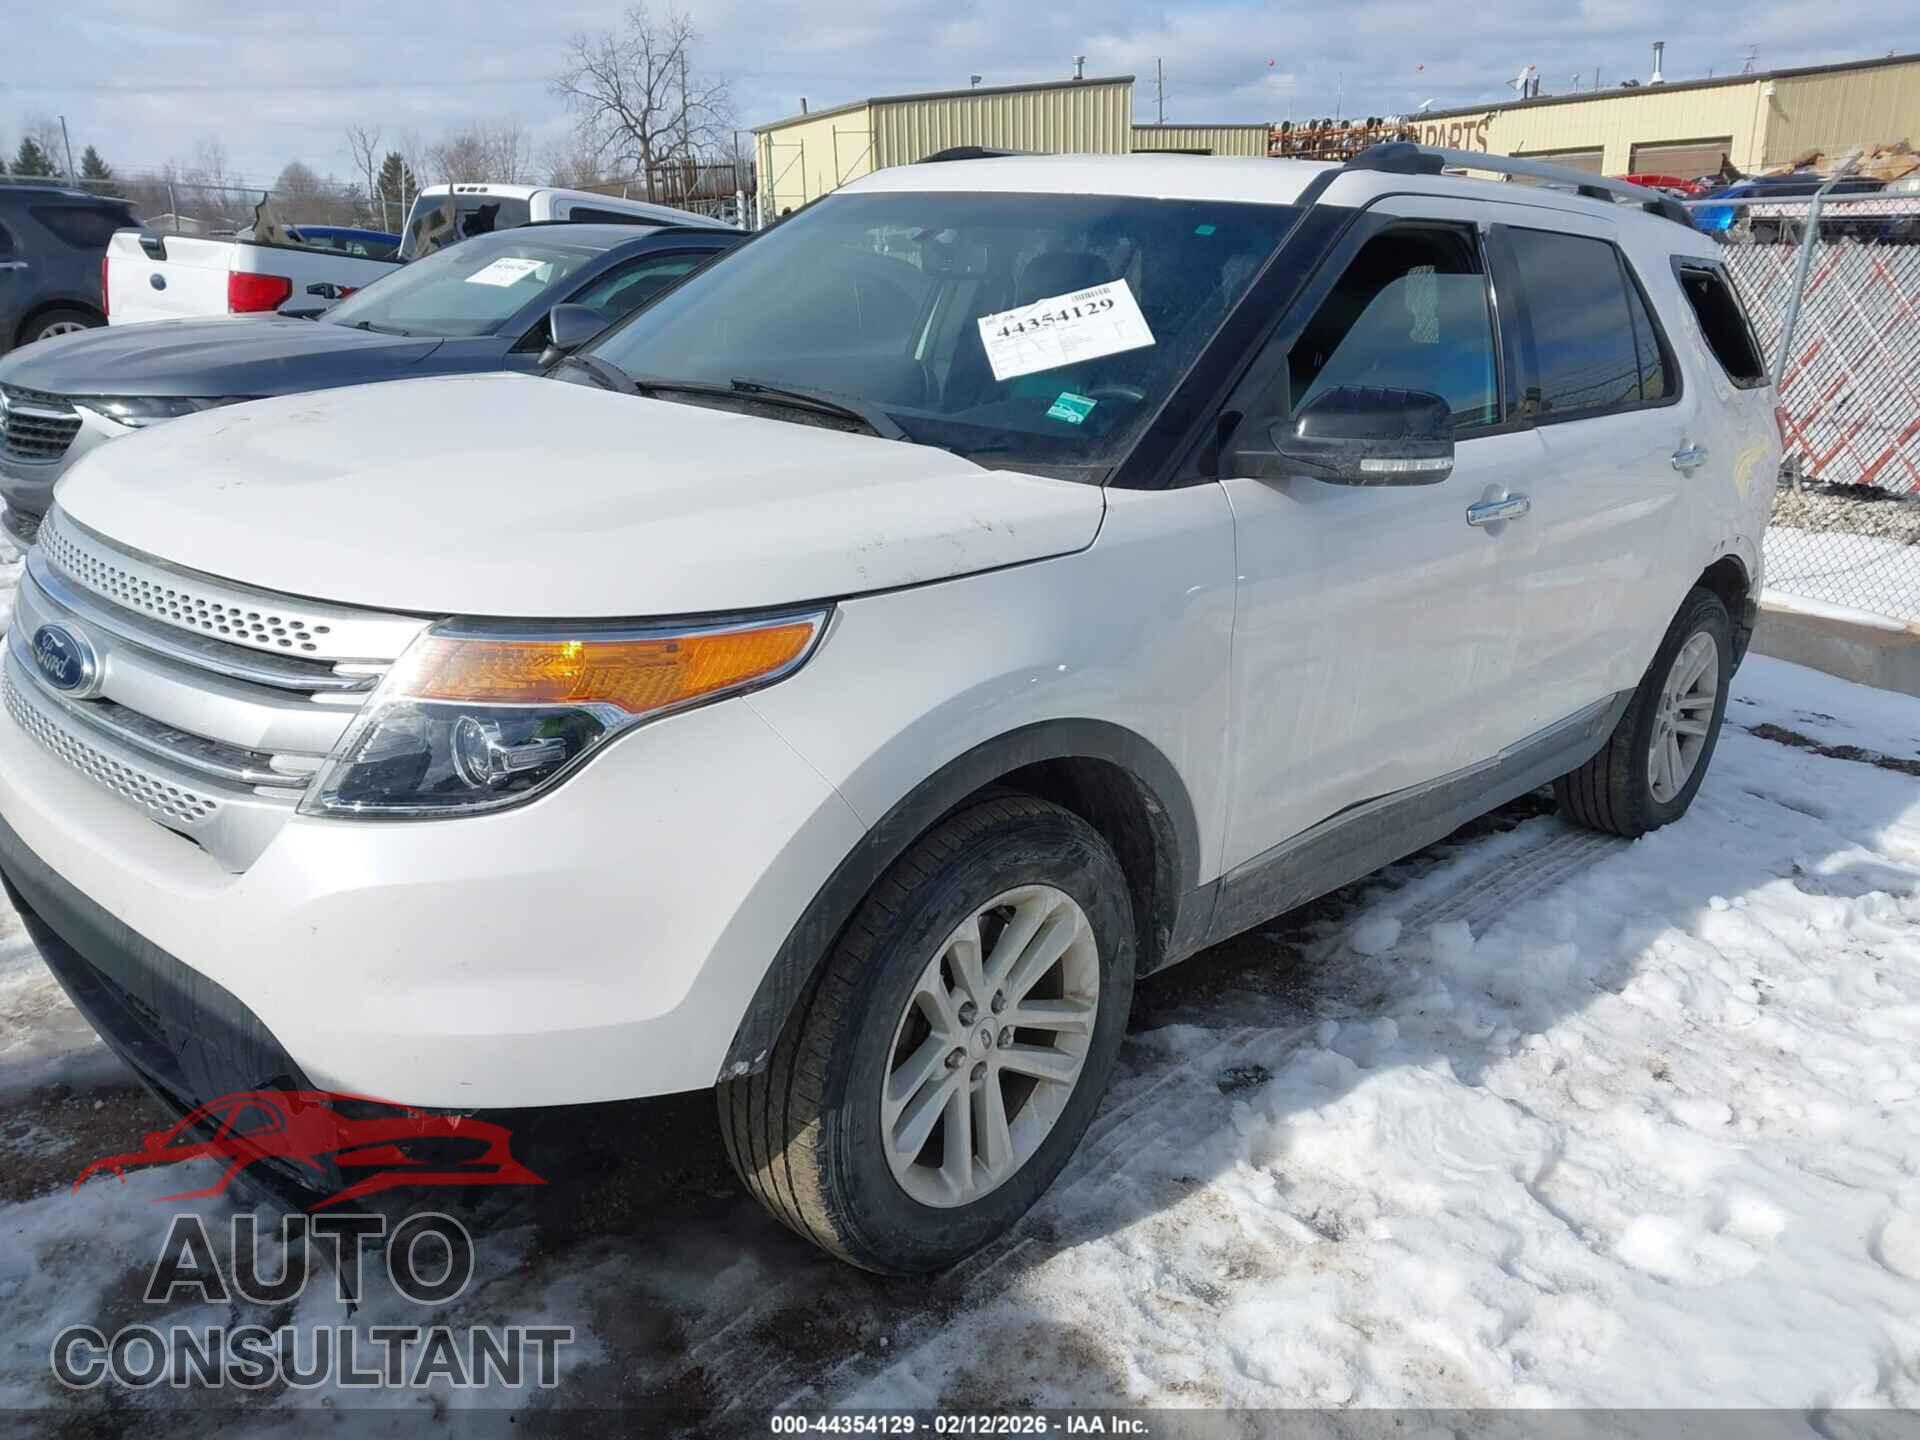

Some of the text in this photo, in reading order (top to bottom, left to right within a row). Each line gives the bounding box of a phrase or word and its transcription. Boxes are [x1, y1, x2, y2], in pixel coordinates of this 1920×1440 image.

[1425, 119, 1489, 153] PARTS
[996, 298, 1115, 337] 44354129
[34, 631, 72, 680] Ford
